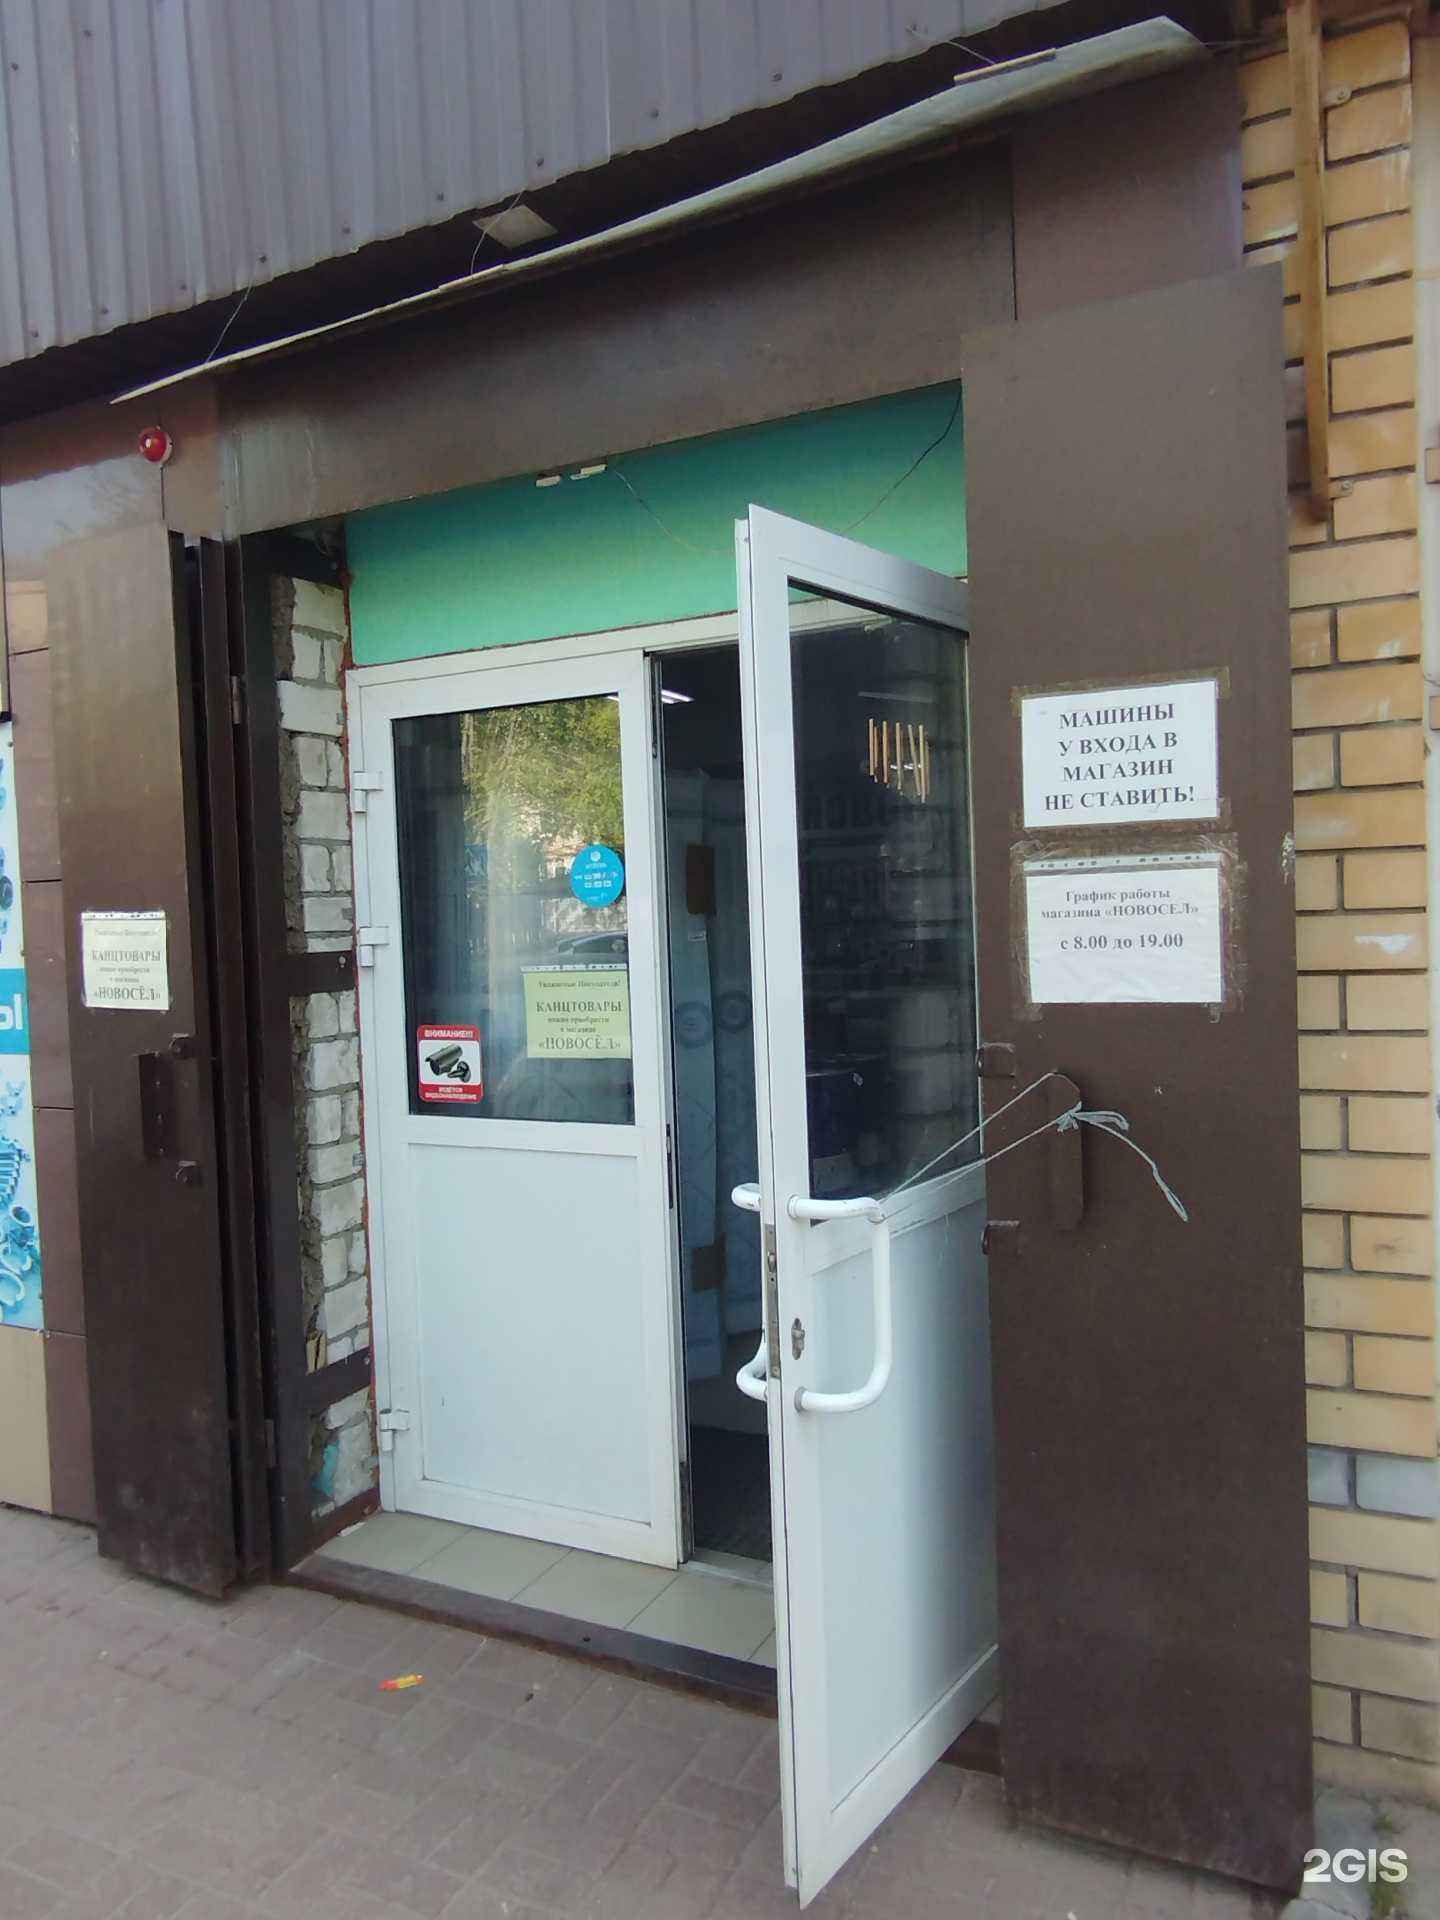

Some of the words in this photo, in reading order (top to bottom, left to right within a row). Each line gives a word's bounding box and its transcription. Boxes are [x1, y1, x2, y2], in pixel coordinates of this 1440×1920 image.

[1058, 703, 1175, 730] МАШИНЫ
[1057, 740, 1073, 757] У
[1079, 734, 1157, 755] ВХОДА
[1163, 731, 1178, 748] В
[1062, 759, 1174, 782] МАГАЗИН
[1044, 793, 1074, 811] НЕ
[1080, 785, 1195, 809] СТАВИТЬ!
[1066, 890, 1116, 904] График
[1119, 888, 1171, 903] работы
[1040, 908, 1101, 919] магазина
[1060, 940, 1068, 950] с
[1073, 935, 1108, 950] 8.00
[1112, 937, 1133, 950] до
[1139, 933, 1184, 949] 19.00
[536, 1000, 623, 1013] КАНЦТОВАРЫ
